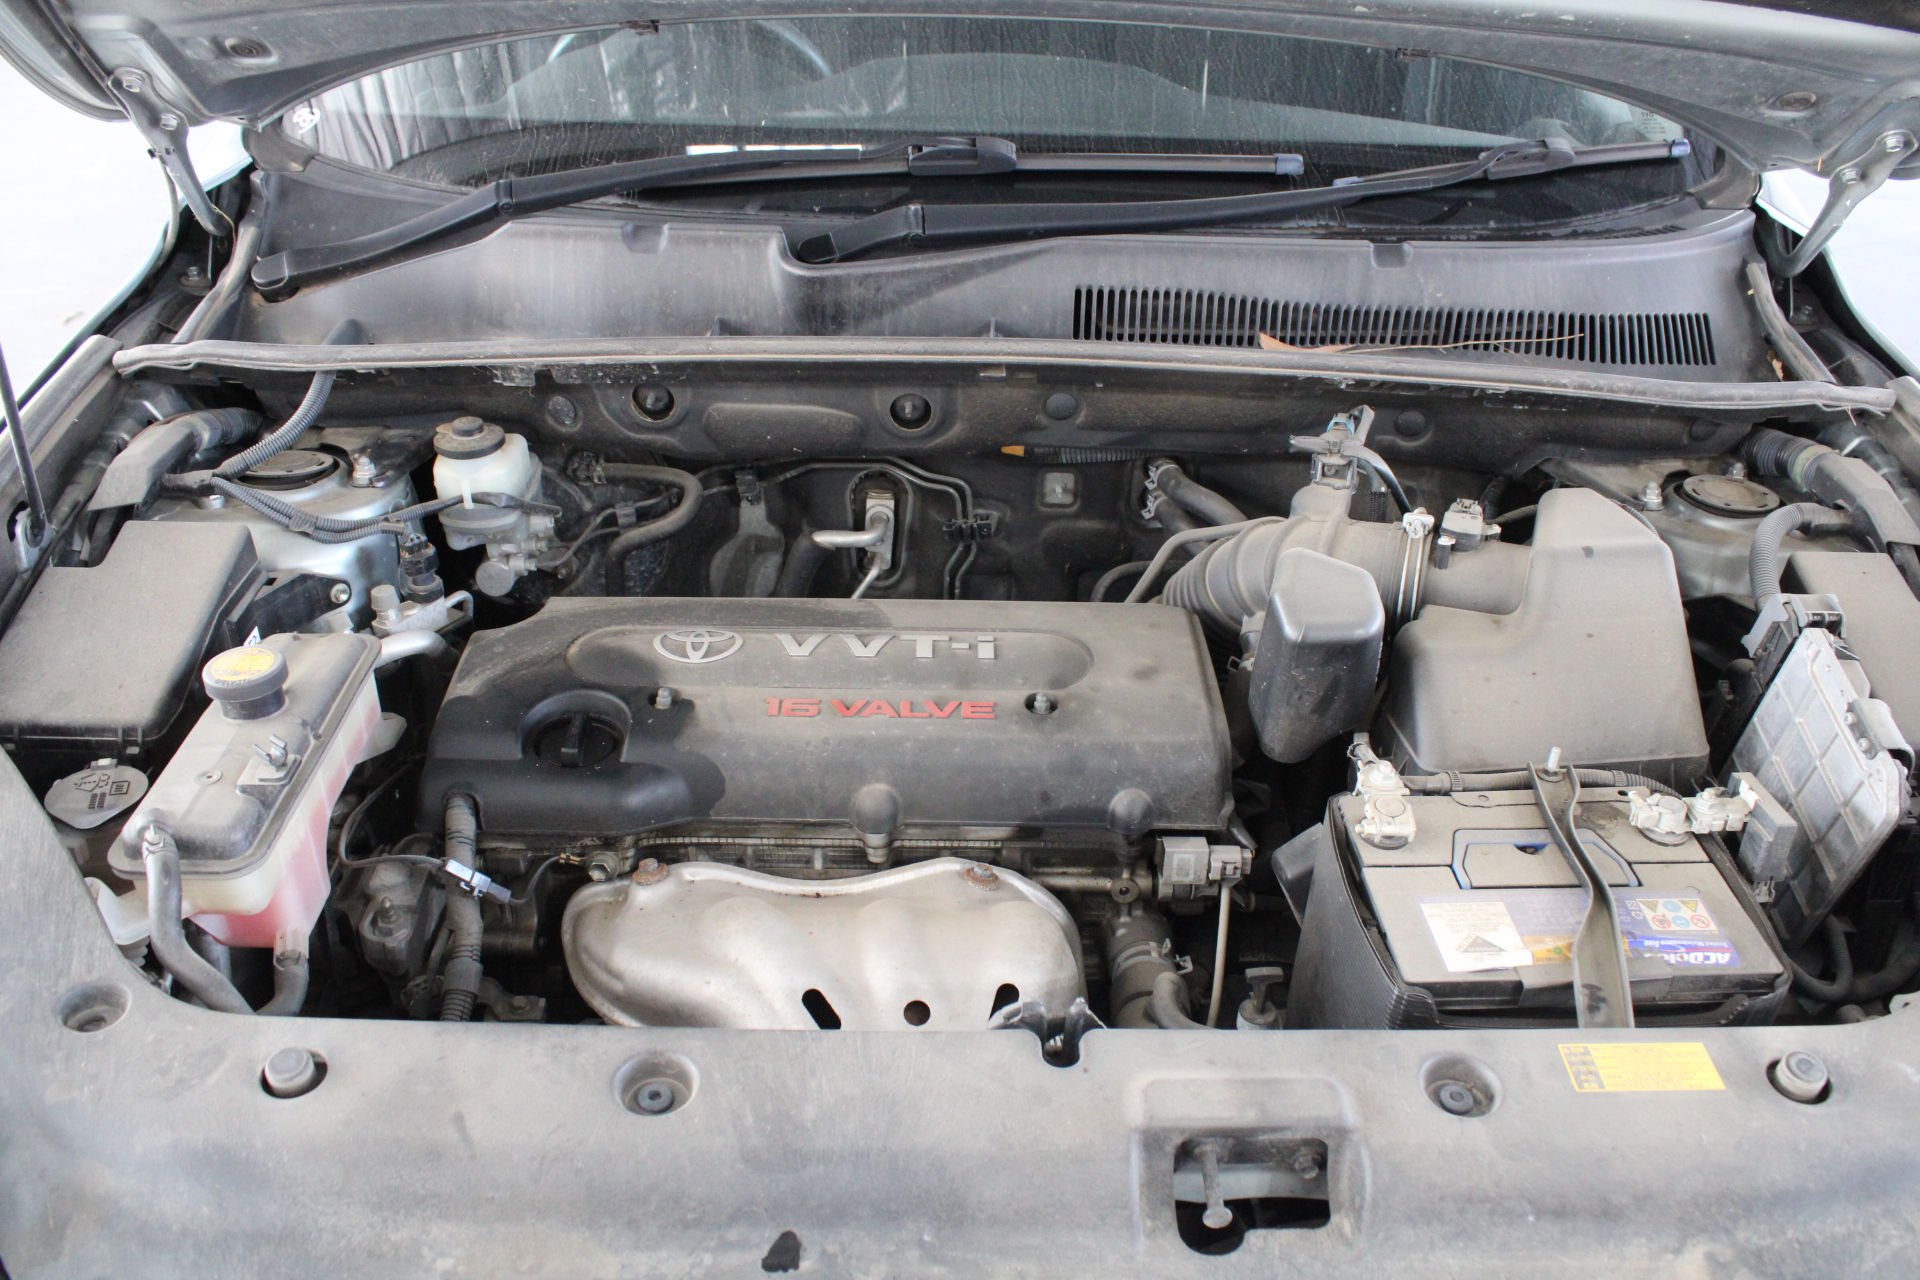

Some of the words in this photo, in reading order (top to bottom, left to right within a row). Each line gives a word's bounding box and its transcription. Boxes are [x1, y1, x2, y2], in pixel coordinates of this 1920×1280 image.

[774, 633, 997, 660] VVT-i
[766, 697, 822, 717] 16
[828, 699, 997, 719] VALVE
